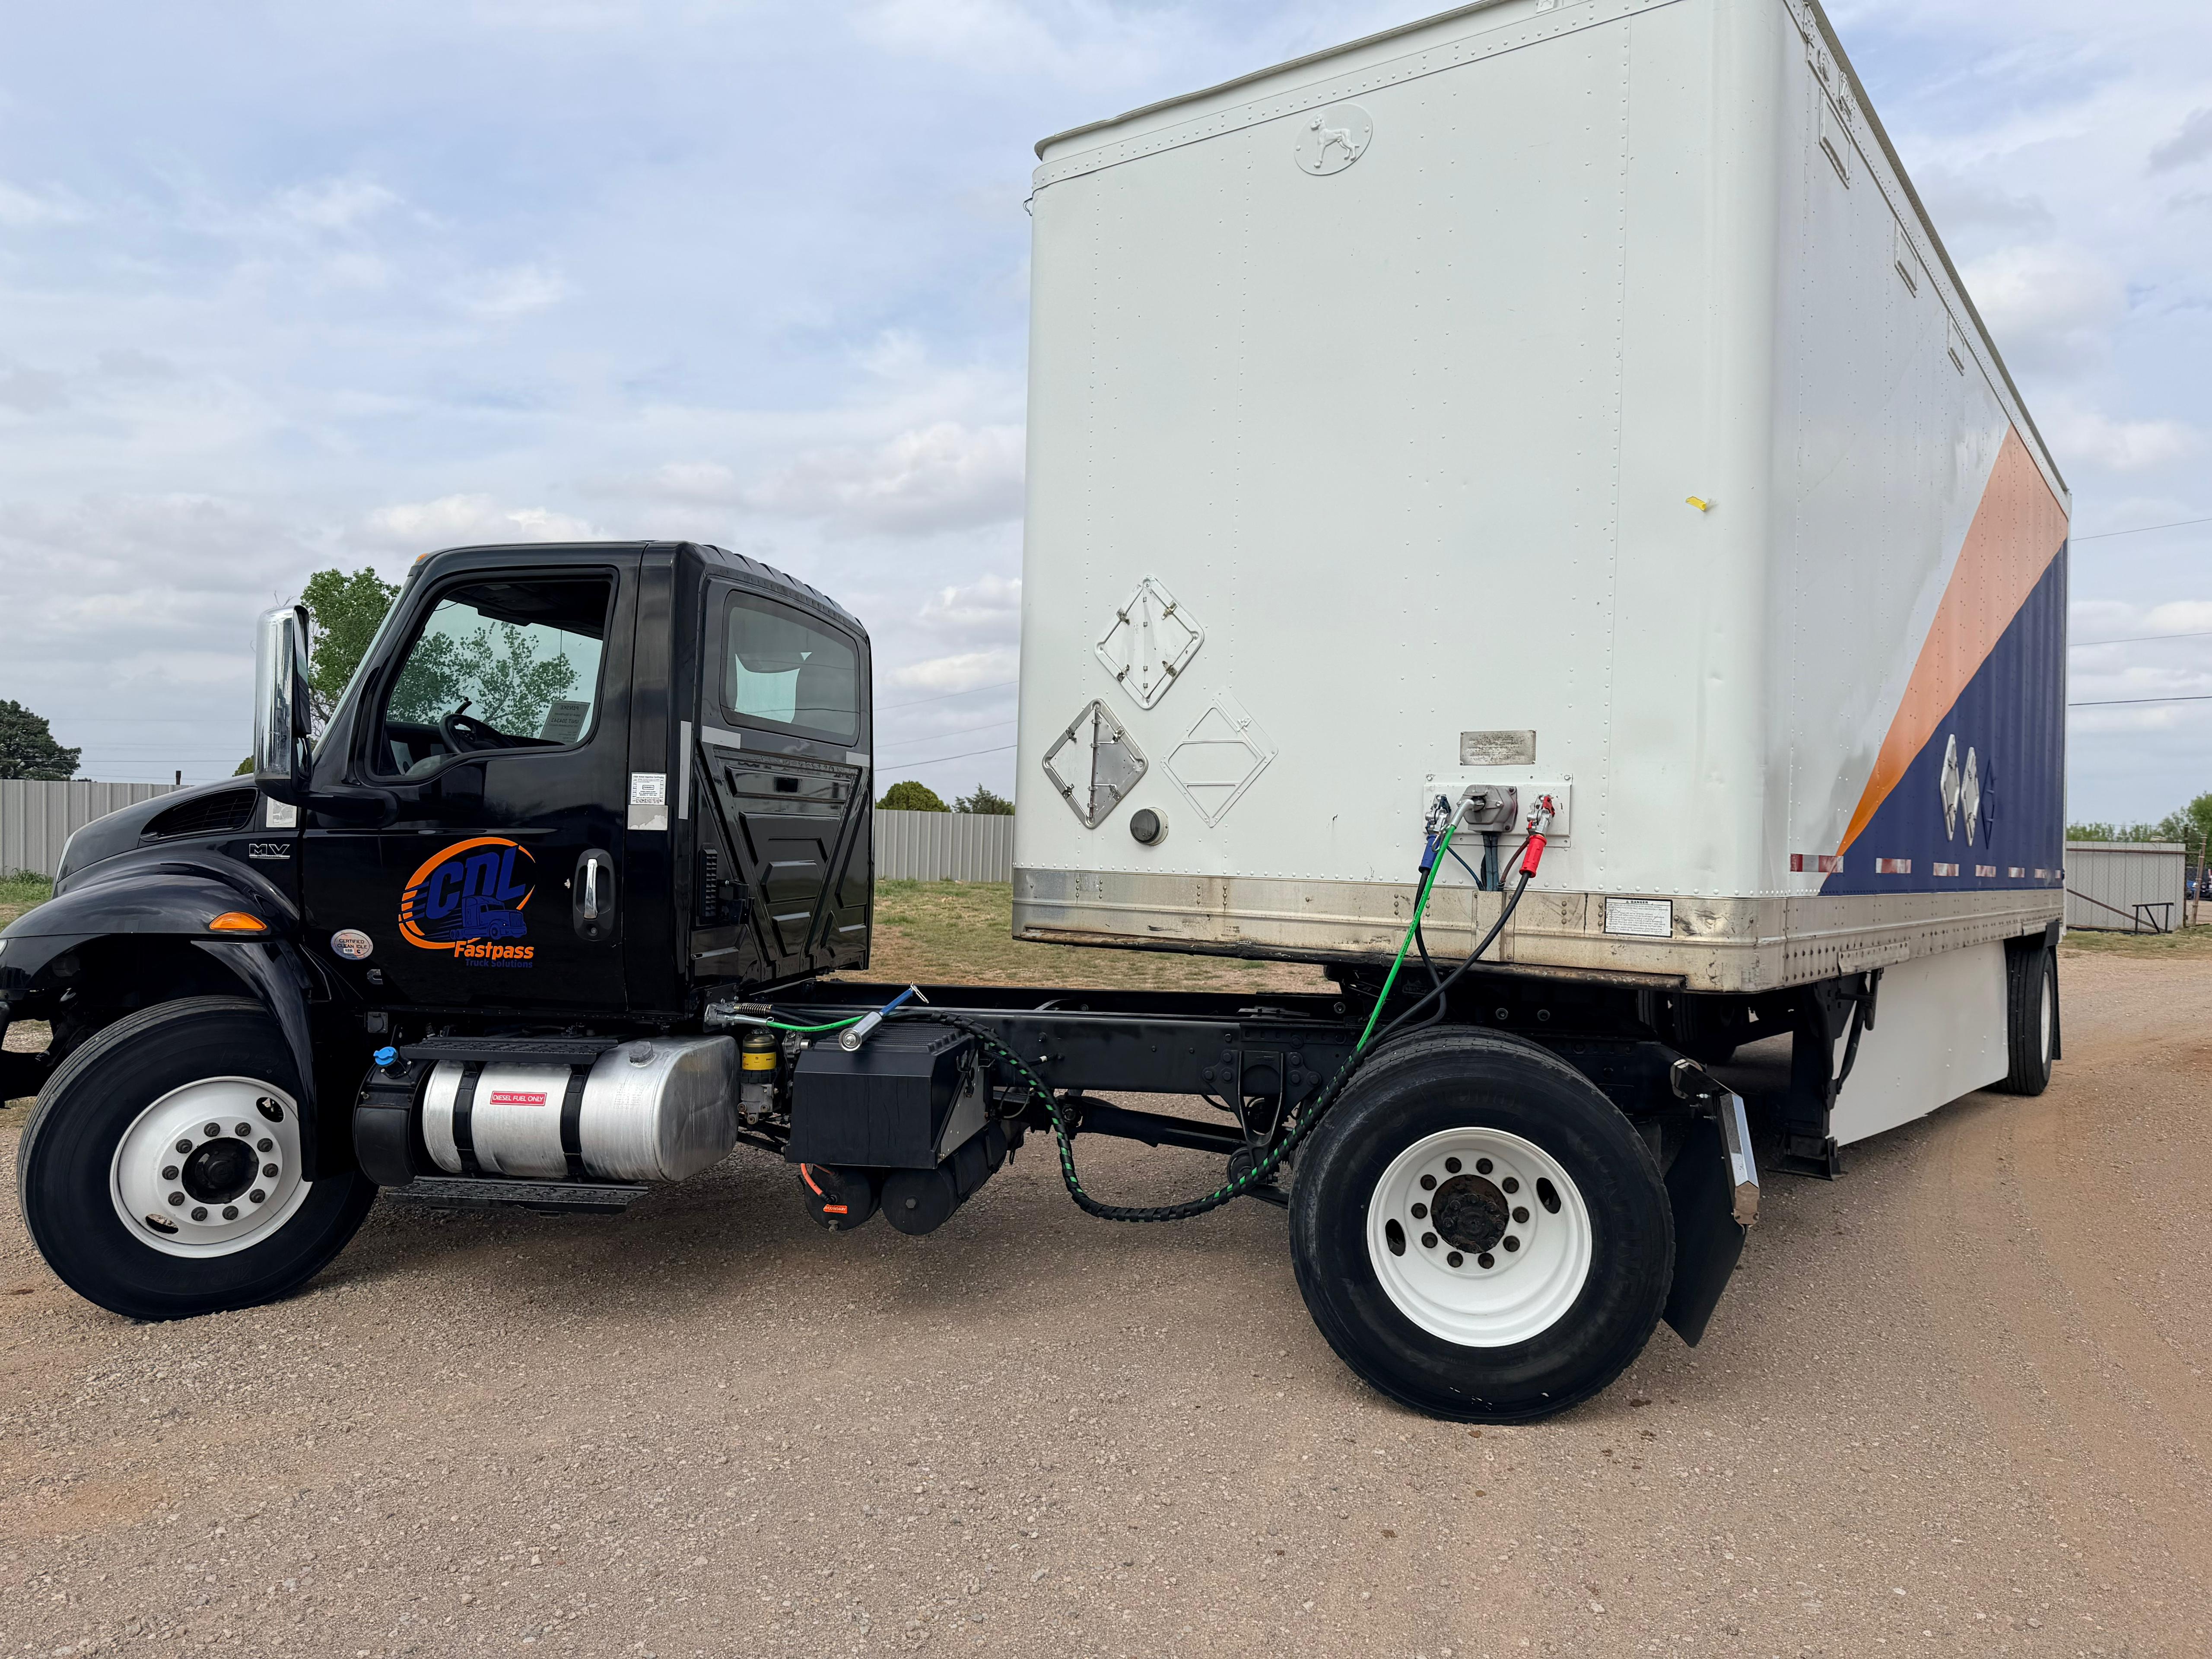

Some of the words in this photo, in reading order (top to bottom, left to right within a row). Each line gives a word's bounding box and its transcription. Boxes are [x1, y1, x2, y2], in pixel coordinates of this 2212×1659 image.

[249, 844, 290, 855] MV
[426, 847, 526, 919] CDL
[454, 941, 534, 960] Fastpass
[465, 958, 489, 967] Truck
[491, 959, 533, 968] Solutions
